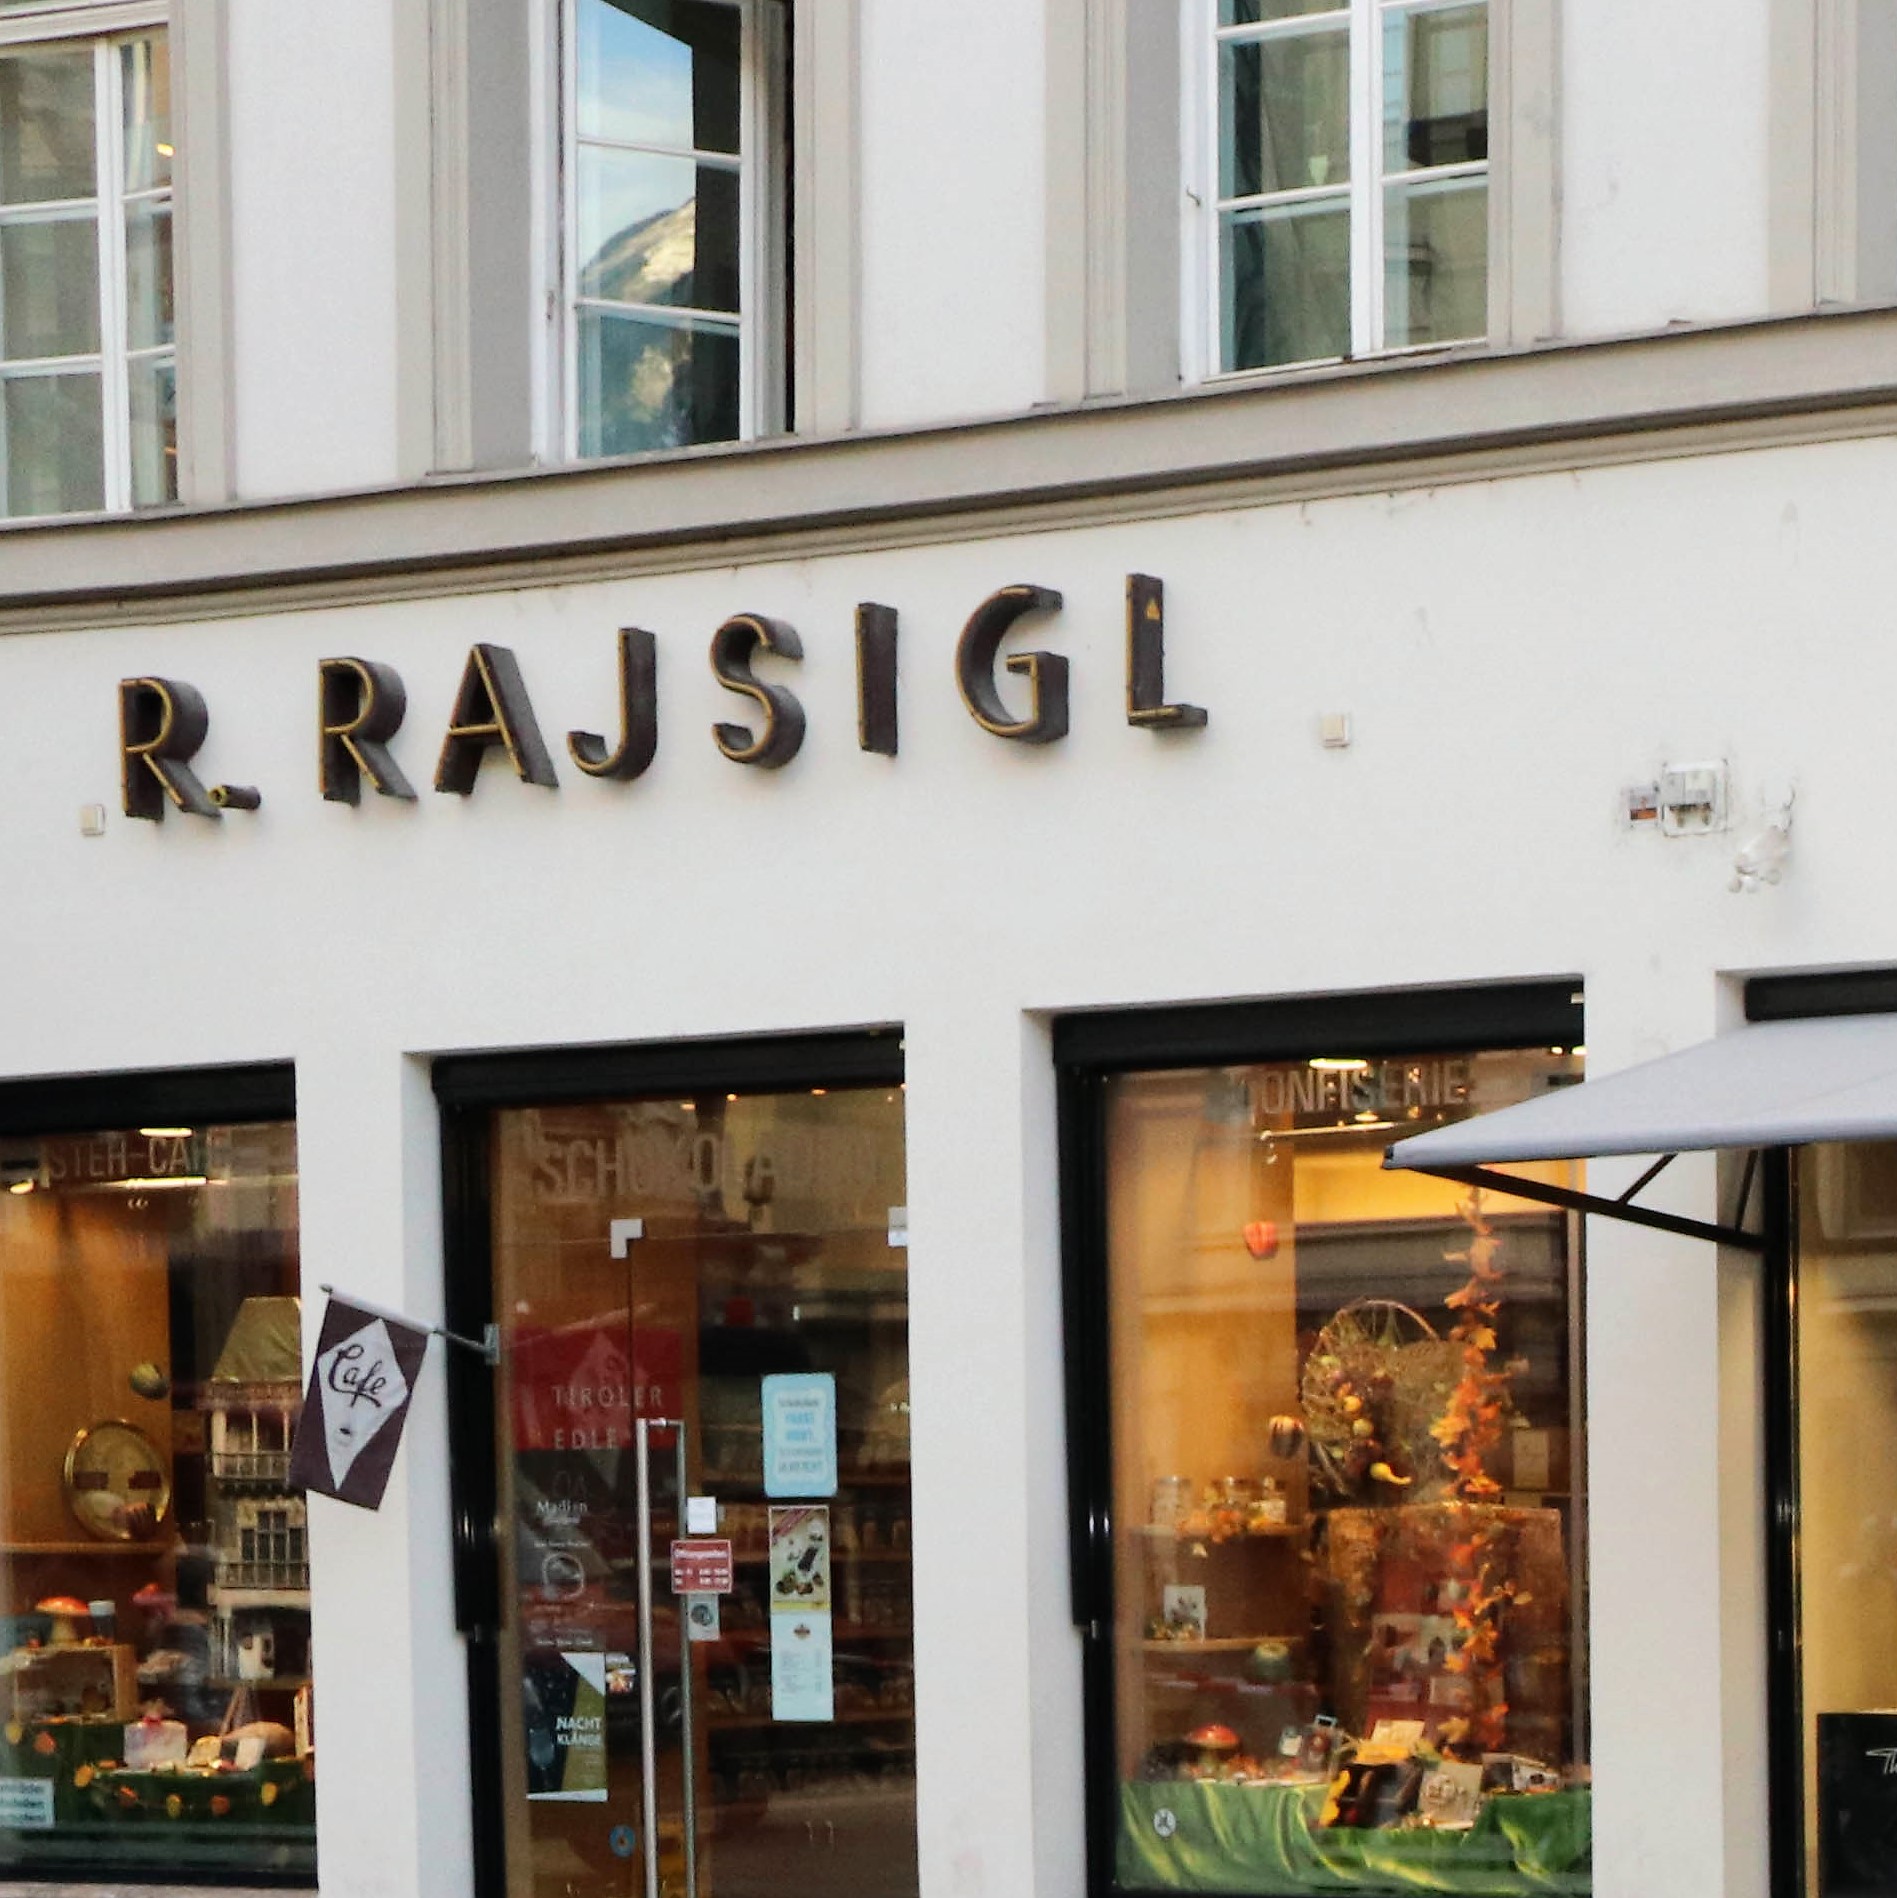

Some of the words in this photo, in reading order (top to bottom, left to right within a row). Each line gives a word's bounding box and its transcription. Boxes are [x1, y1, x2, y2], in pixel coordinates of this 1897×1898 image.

[118, 675, 263, 820] R.
[317, 571, 1209, 805] RAJSIGL
[1230, 1058, 1467, 1115] ONFISERIE
[552, 1384, 663, 1408] TIROLER
